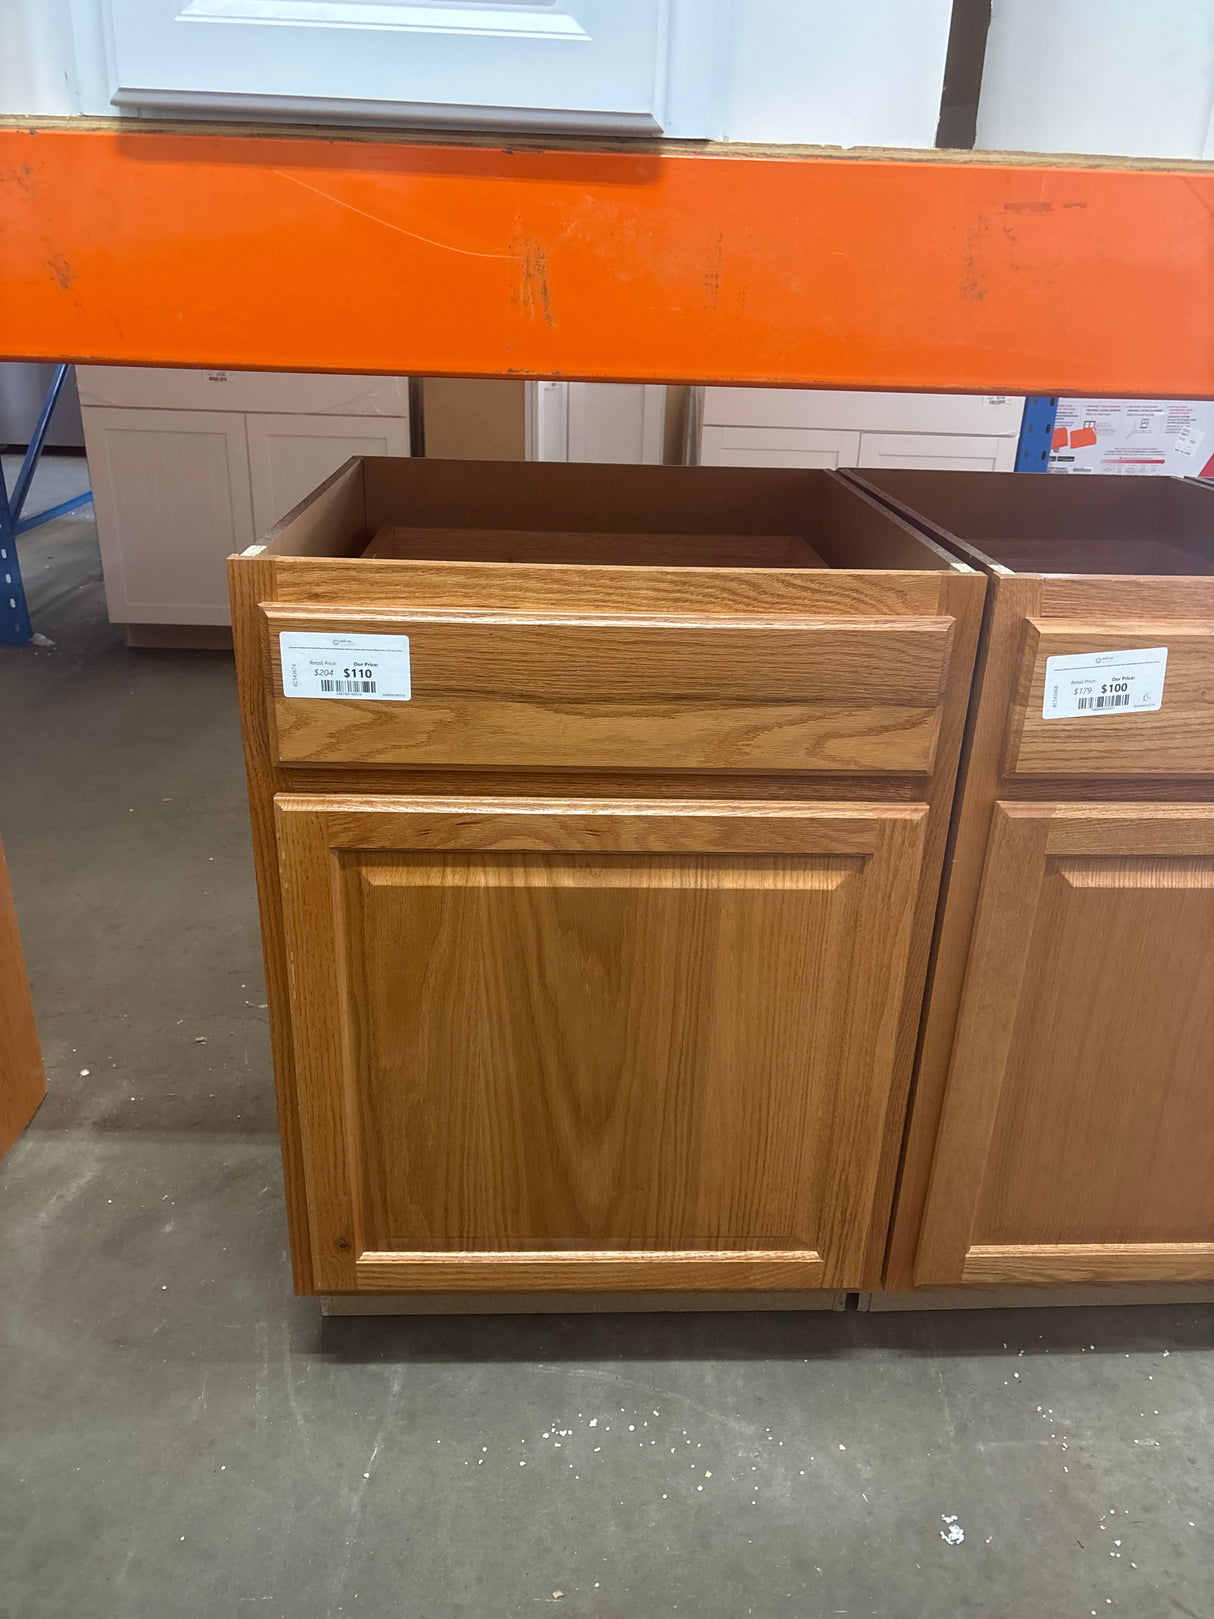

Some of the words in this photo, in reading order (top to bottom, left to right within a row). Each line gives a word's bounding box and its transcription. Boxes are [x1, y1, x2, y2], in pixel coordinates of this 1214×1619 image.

[314, 668, 334, 677] $204
[343, 668, 372, 678] $110
[1074, 687, 1092, 696] $179
[1101, 683, 1128, 694] $100
